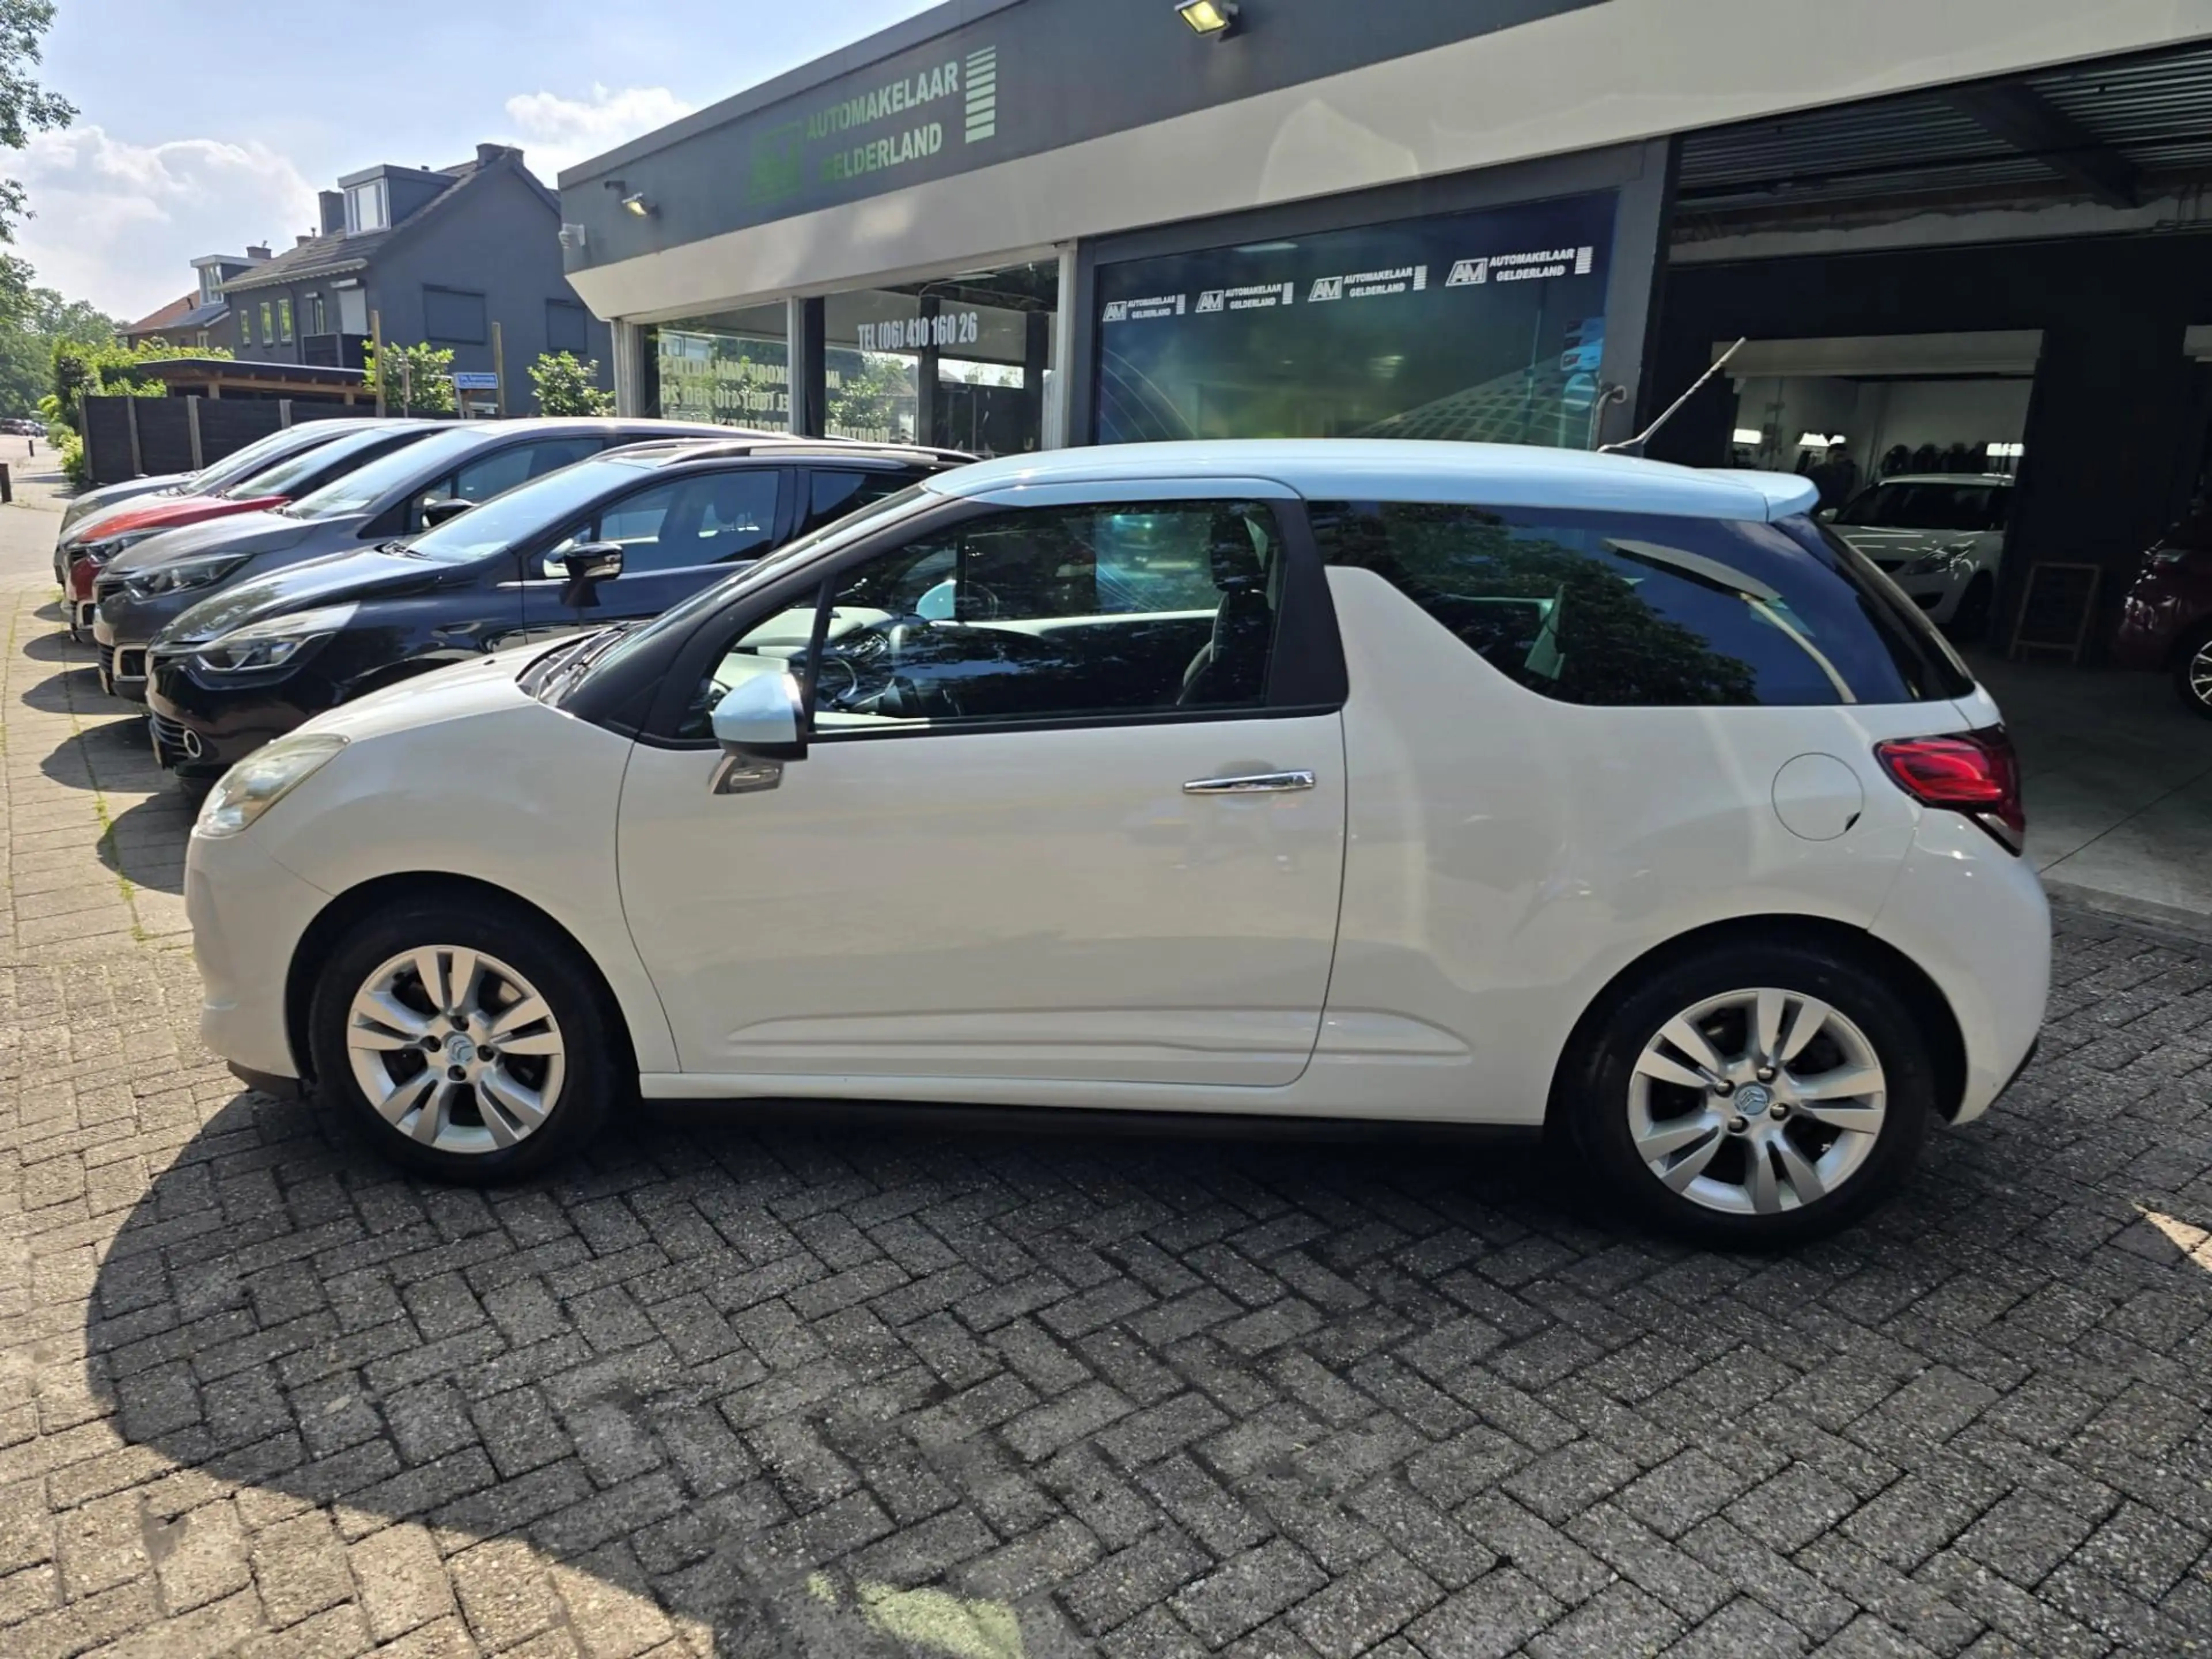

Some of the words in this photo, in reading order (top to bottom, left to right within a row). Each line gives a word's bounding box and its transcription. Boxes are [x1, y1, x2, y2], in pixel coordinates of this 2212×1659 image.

[807, 61, 959, 141] AUTOMAKELAAR
[1445, 258, 1488, 286] AM
[1490, 248, 1575, 267] AUTOMAKELAAR
[1496, 265, 1565, 282] GELDERLAND
[1196, 290, 1224, 313] AM
[1225, 283, 1282, 298] AUTOMAKELAAR
[1308, 277, 1343, 302] AM
[1343, 267, 1412, 284] AUTOMAKELAAR
[1349, 282, 1406, 297] GELDERLAND
[1103, 301, 1127, 321] AM
[1229, 298, 1277, 310] GELDERLAND
[858, 323, 877, 351] TEL
[878, 320, 904, 349] (06)
[906, 316, 930, 347] 410
[931, 314, 956, 345] 160
[959, 312, 978, 343] 26
